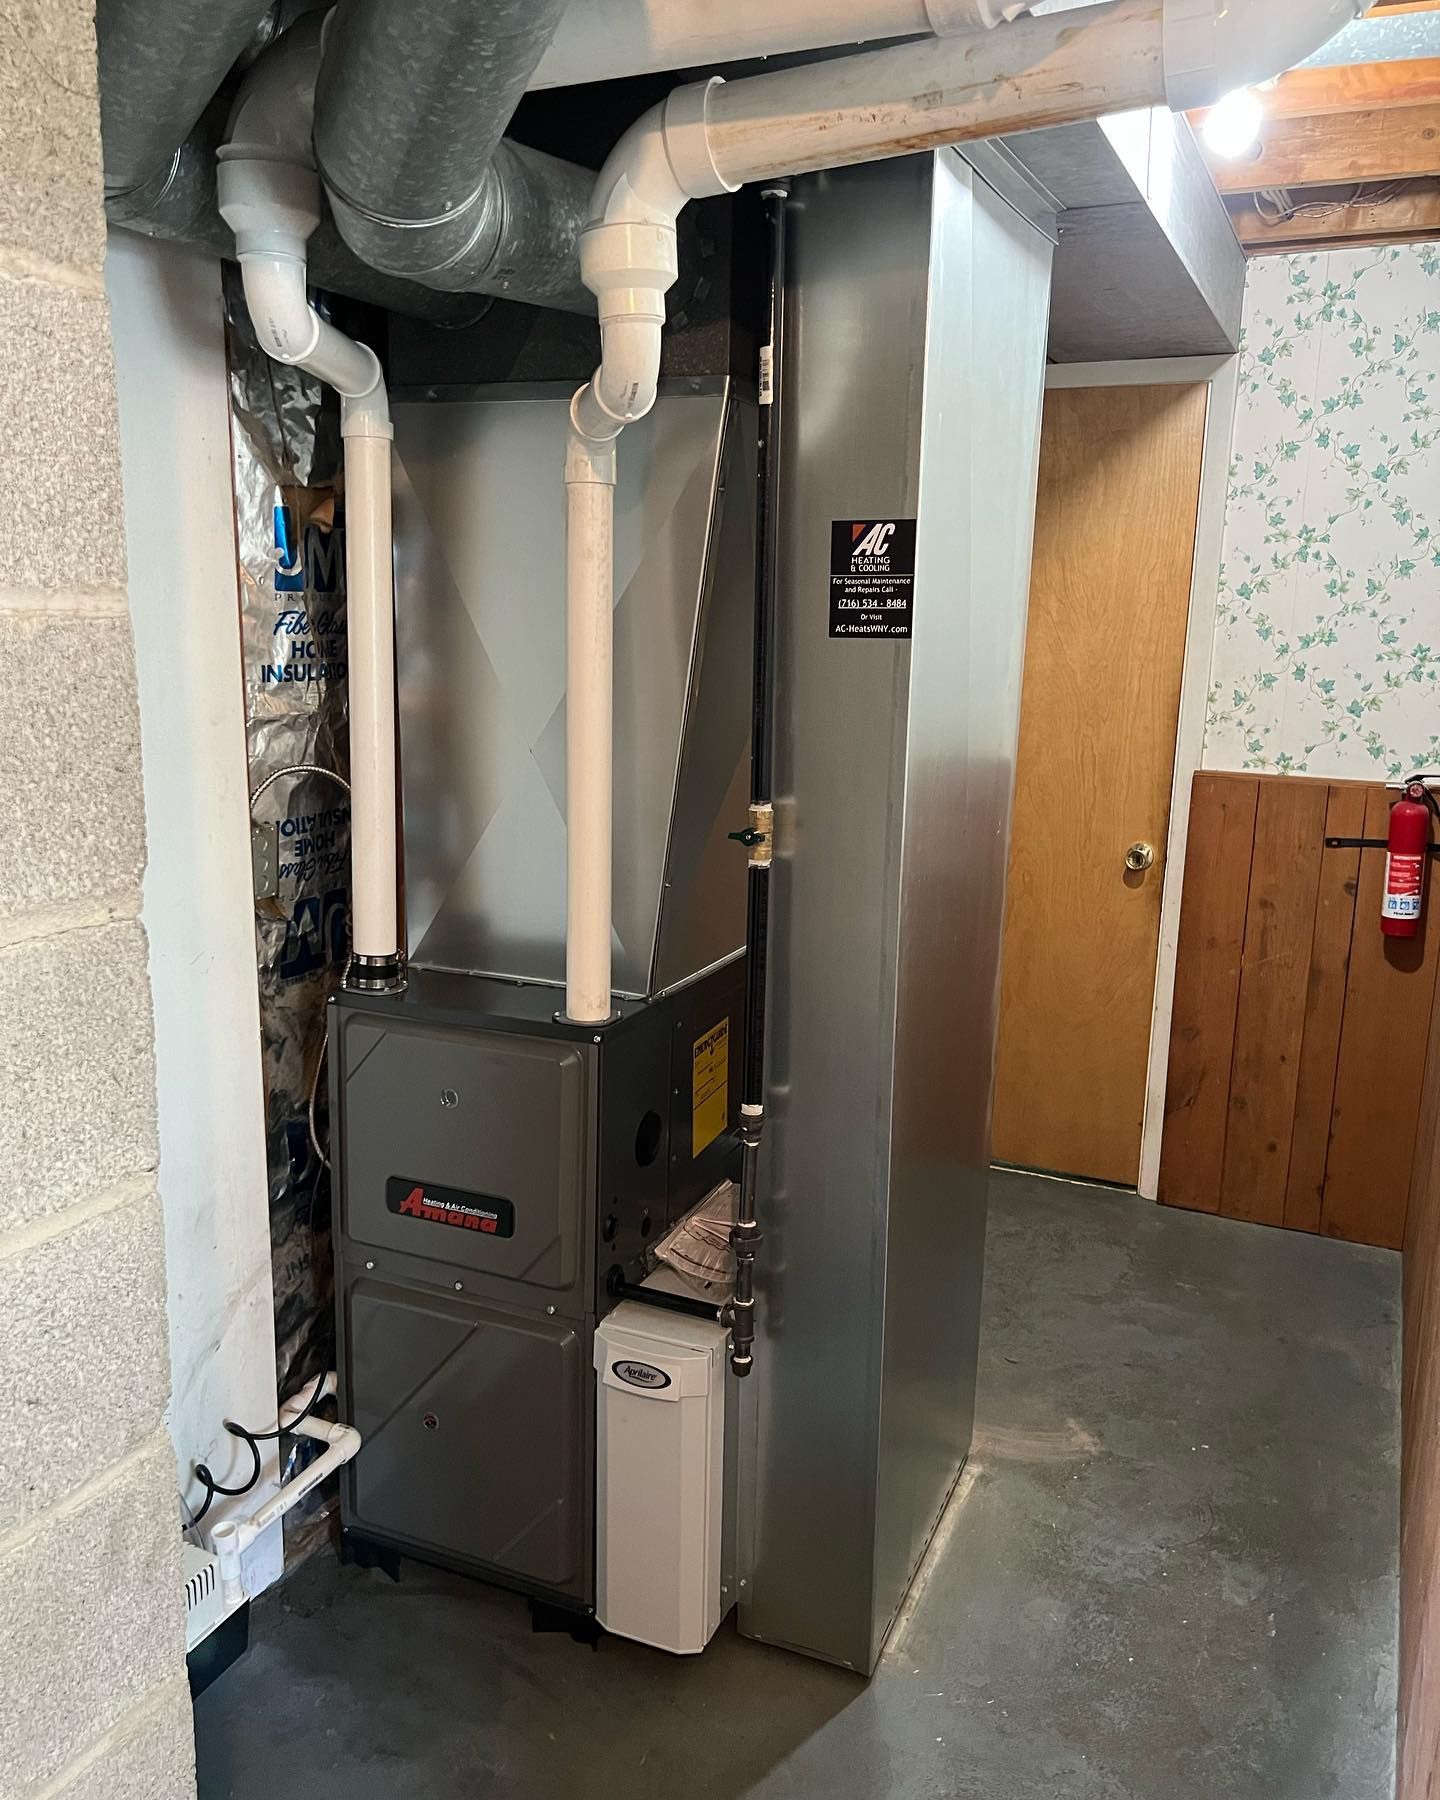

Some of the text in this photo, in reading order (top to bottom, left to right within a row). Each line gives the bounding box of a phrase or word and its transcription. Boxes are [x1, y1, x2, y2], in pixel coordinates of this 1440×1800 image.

[852, 523, 896, 555] AC
[850, 564, 890, 572] & COOLING
[838, 599, 860, 608] (716)
[862, 599, 878, 608] 534
[886, 599, 907, 608] 8484
[273, 610, 314, 635] Fibe
[835, 624, 908, 633] AC-HeatsWNY.com
[294, 831, 335, 857] HOME
[279, 858, 316, 884] Glass
[400, 1187, 498, 1233] Amana
[423, 1197, 445, 1209] Heating
[451, 1202, 460, 1211] Air
[460, 1205, 498, 1220] Conditioning
[623, 1365, 657, 1381] Aprilaire
